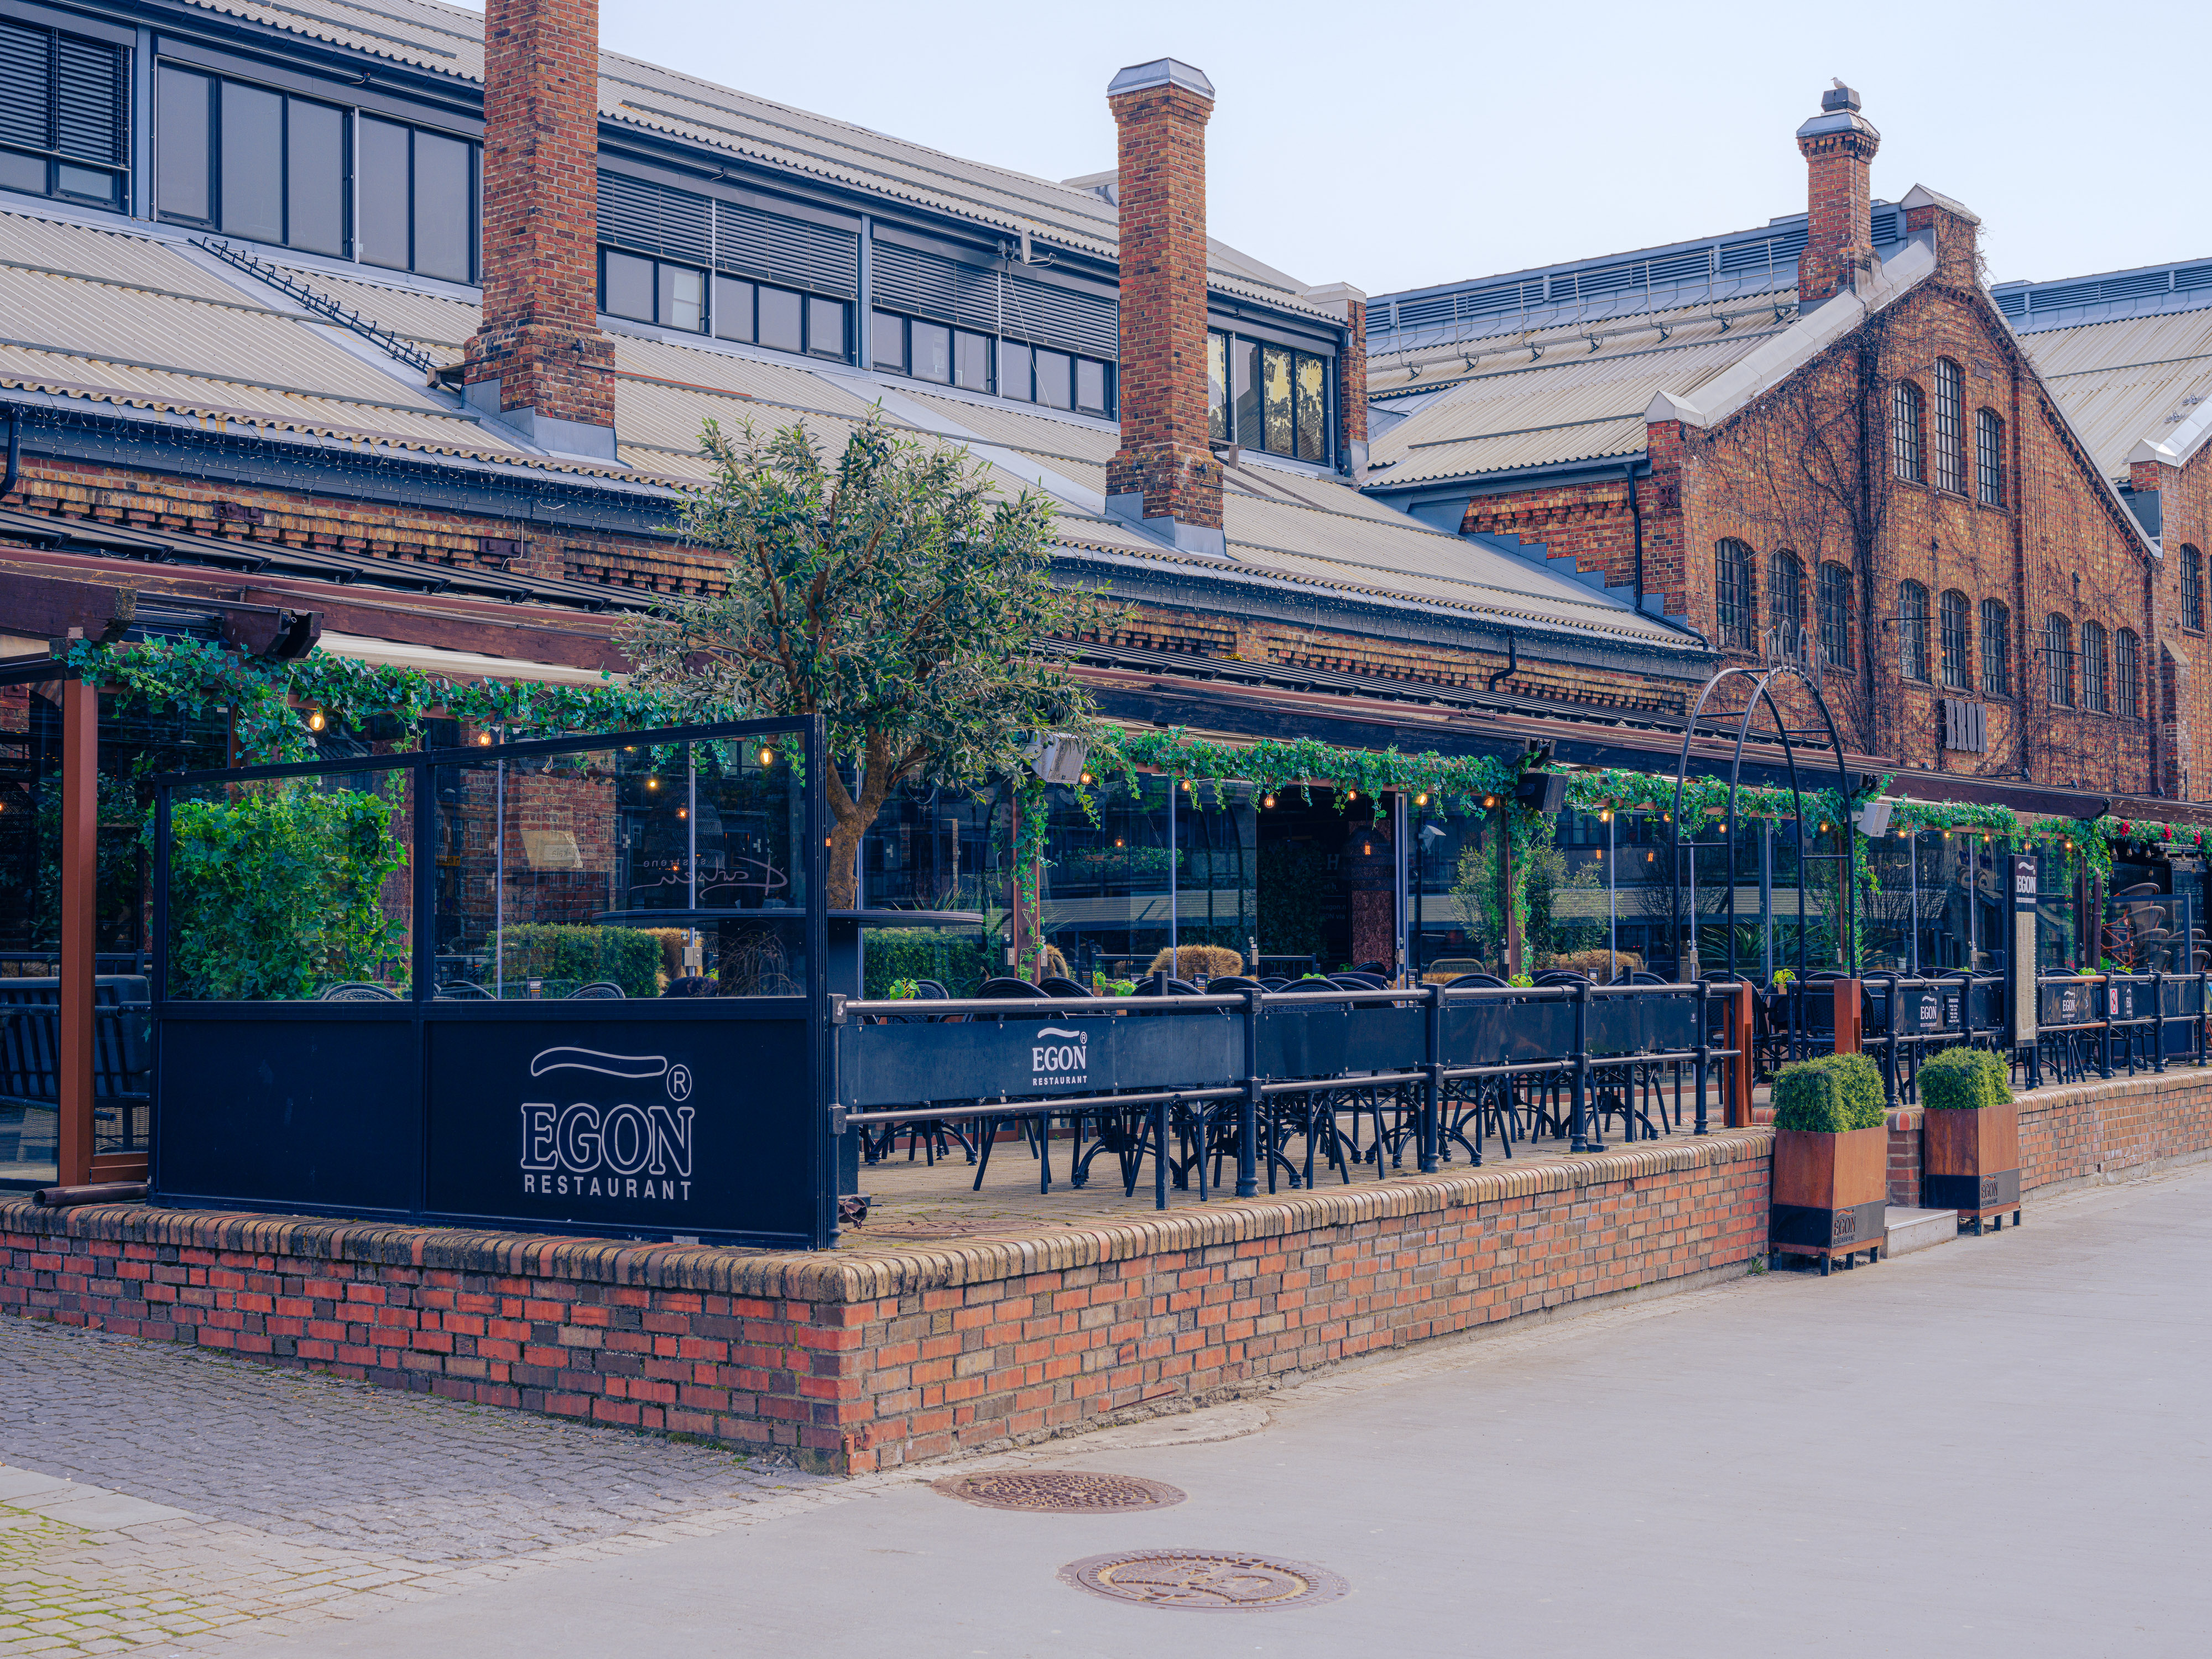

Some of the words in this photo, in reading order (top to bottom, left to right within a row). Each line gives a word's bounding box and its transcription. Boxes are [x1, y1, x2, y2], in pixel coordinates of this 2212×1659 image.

[1763, 620, 1825, 701] EGON
[1944, 698, 1989, 753] BROR
[2016, 875, 2036, 894] EGON
[1920, 1006, 1937, 1020] EGON
[2062, 999, 2075, 1011] EGON
[1032, 1046, 1087, 1072] EGON
[1032, 1076, 1087, 1086] RESTAURANT
[520, 1103, 695, 1177] EGON
[524, 1174, 691, 1201] RESTAURANT
[1981, 1182, 1998, 1199] EGON
[1981, 1198, 1998, 1207] RESTAURANT
[1833, 1216, 1856, 1237] EGON
[1833, 1234, 1855, 1245] RESTAURANT
